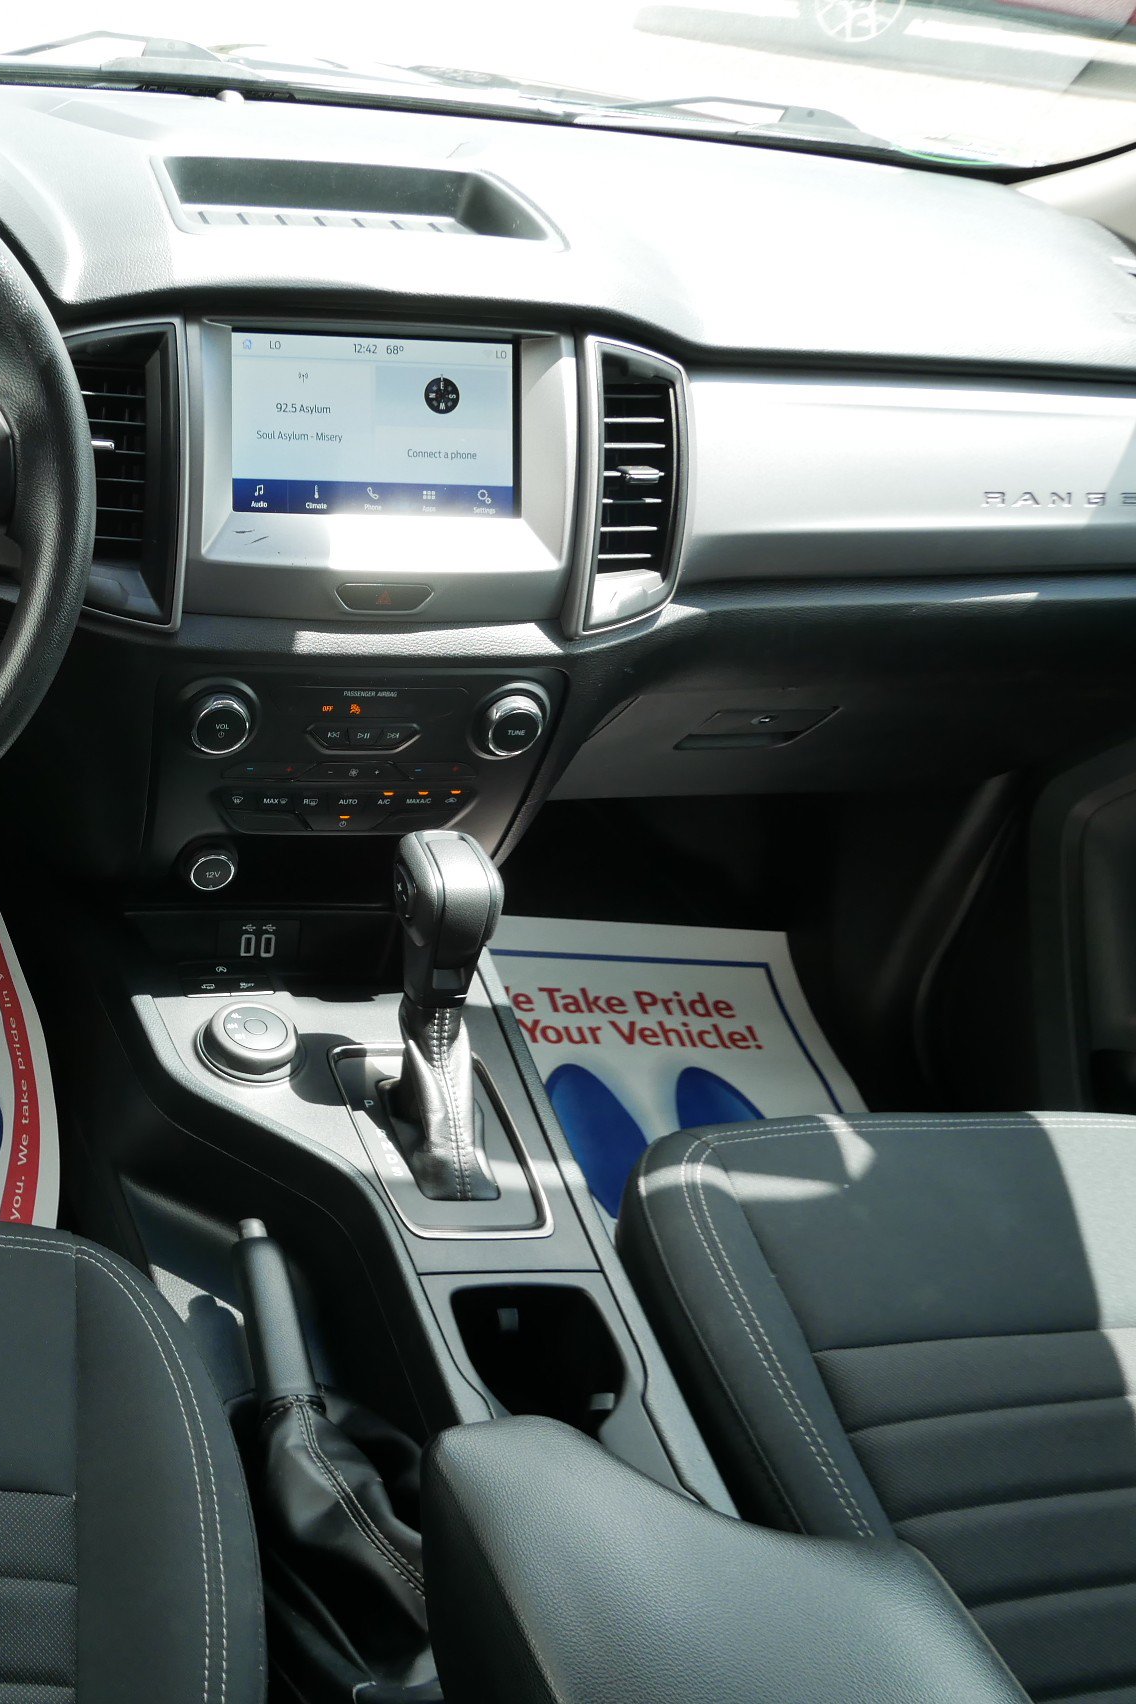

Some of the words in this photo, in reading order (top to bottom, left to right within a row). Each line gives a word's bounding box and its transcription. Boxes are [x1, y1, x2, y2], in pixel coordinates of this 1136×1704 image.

[269, 340, 282, 351] LO
[353, 343, 378, 355] 12:42
[495, 350, 507, 360] LO
[275, 402, 298, 414] 92.5
[299, 403, 331, 416] Asylum
[256, 429, 276, 440] Soul
[277, 430, 309, 443] Asylum
[315, 432, 343, 444] Misery
[407, 448, 442, 459] Connect
[443, 451, 449, 459] a
[450, 449, 477, 462] phone
[250, 500, 268, 508] Audio
[305, 501, 328, 510] Climate
[364, 503, 382, 512] Phone
[473, 506, 496, 516] Settings
[507, 729, 526, 737] TUNE
[377, 798, 391, 806] A/C
[205, 871, 221, 879] 12V
[2, 990, 12, 1008] in
[504, 986, 535, 1013] e
[537, 987, 629, 1015] Take
[633, 990, 736, 1019] Pride
[517, 1018, 603, 1045] Your
[609, 1020, 764, 1051] Vehicle!
[10, 1017, 26, 1070] pride
[21, 1079, 29, 1125] take
[363, 1099, 374, 1108] P
[17, 1134, 29, 1166] We
[10, 1175, 25, 1220] you.
